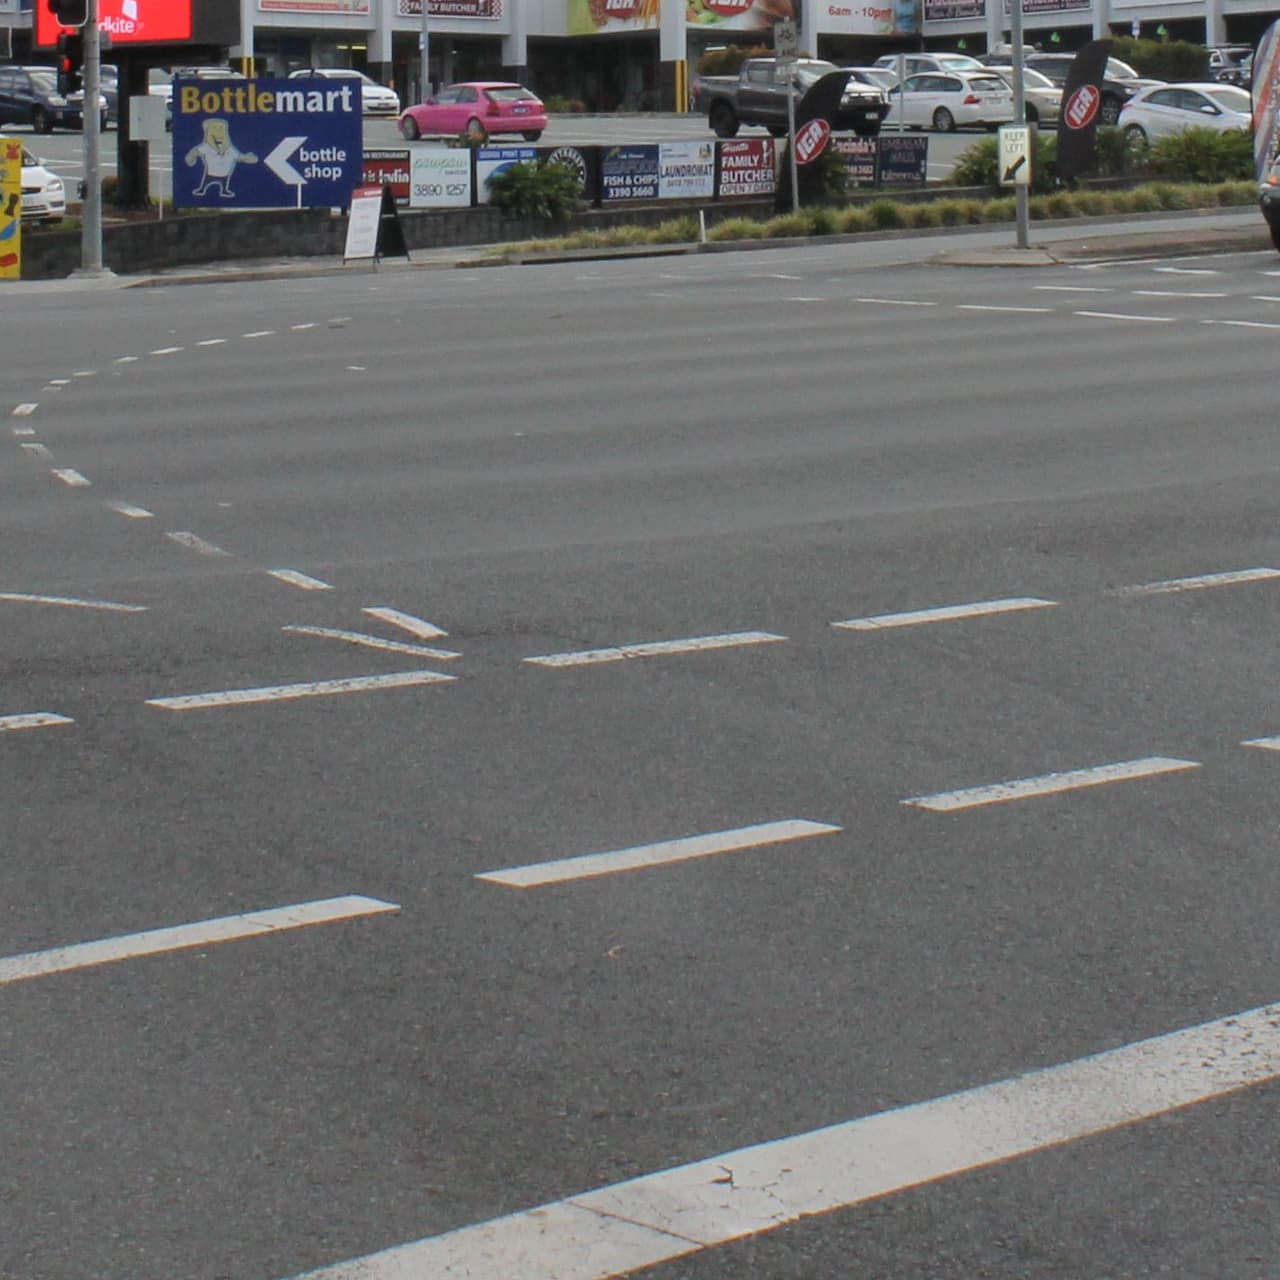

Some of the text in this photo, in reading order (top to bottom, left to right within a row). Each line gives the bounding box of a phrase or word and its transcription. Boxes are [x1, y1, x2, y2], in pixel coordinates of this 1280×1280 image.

[440, 3, 477, 12] BUTCHER
[828, 6, 851, 17] 6am
[180, 84, 353, 114] Bottlemart
[1070, 88, 1094, 125] IGA
[796, 122, 825, 160] IGA
[299, 147, 347, 162] bottle
[722, 154, 759, 168] FAMILY
[304, 164, 342, 181] shop
[660, 164, 713, 178] LAUNDROMAT
[721, 169, 774, 184] BUTCHER
[603, 175, 624, 186] FISH
[625, 176, 632, 185] &
[633, 174, 658, 185] CHIPS
[414, 183, 467, 196] 3890 1257
[608, 187, 631, 198] 3390
